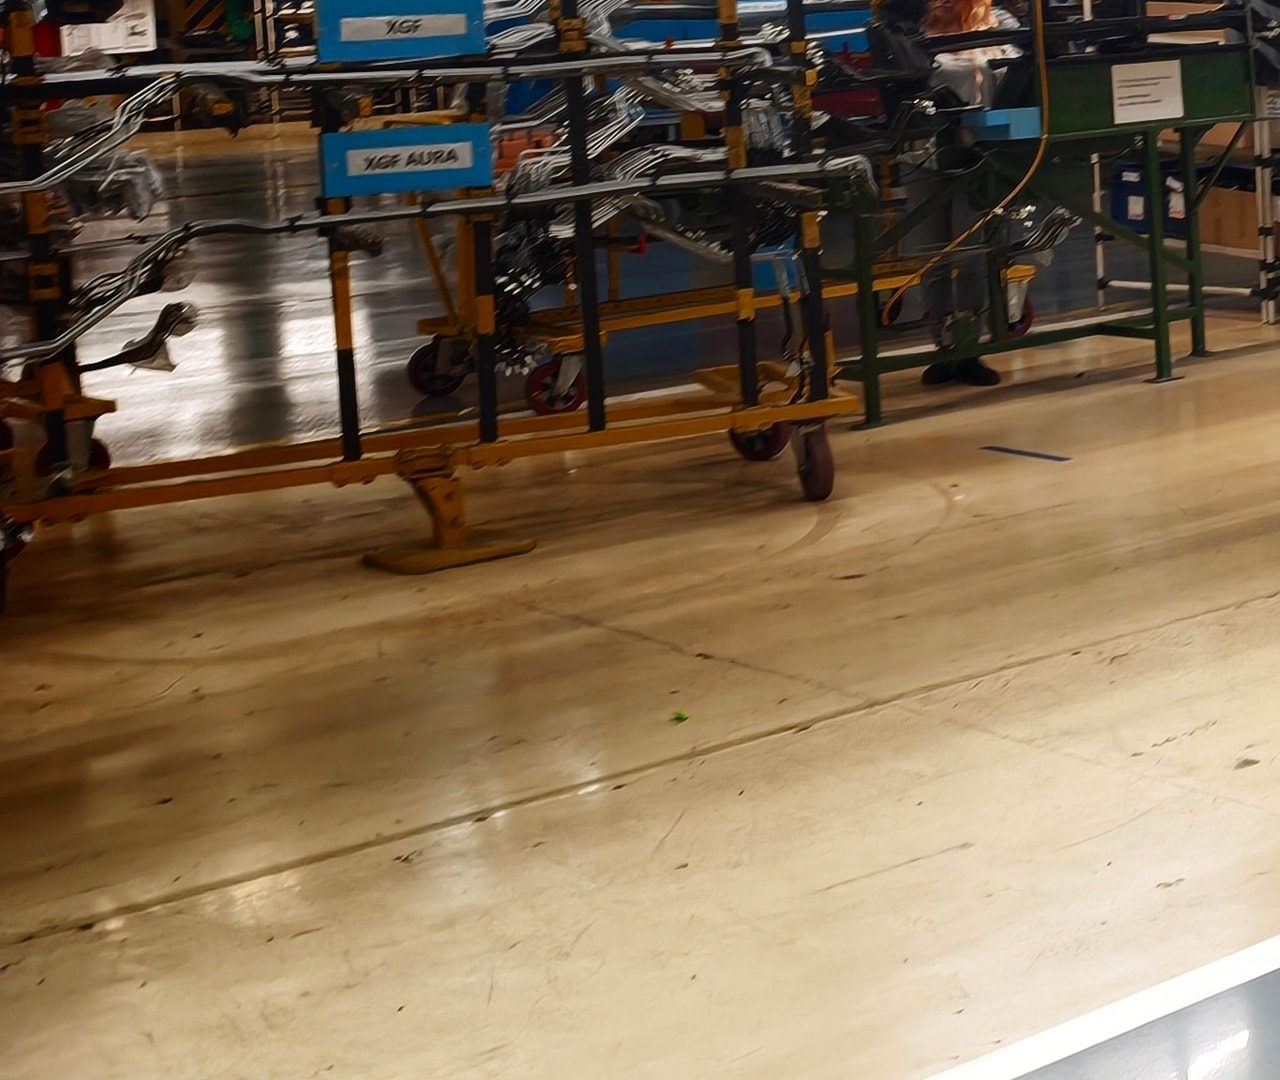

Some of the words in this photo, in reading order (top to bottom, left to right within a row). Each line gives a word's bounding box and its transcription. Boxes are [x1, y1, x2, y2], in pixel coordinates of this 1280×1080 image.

[384, 18, 423, 36] XGF
[363, 153, 401, 172] XGF
[405, 147, 458, 167] AURA
